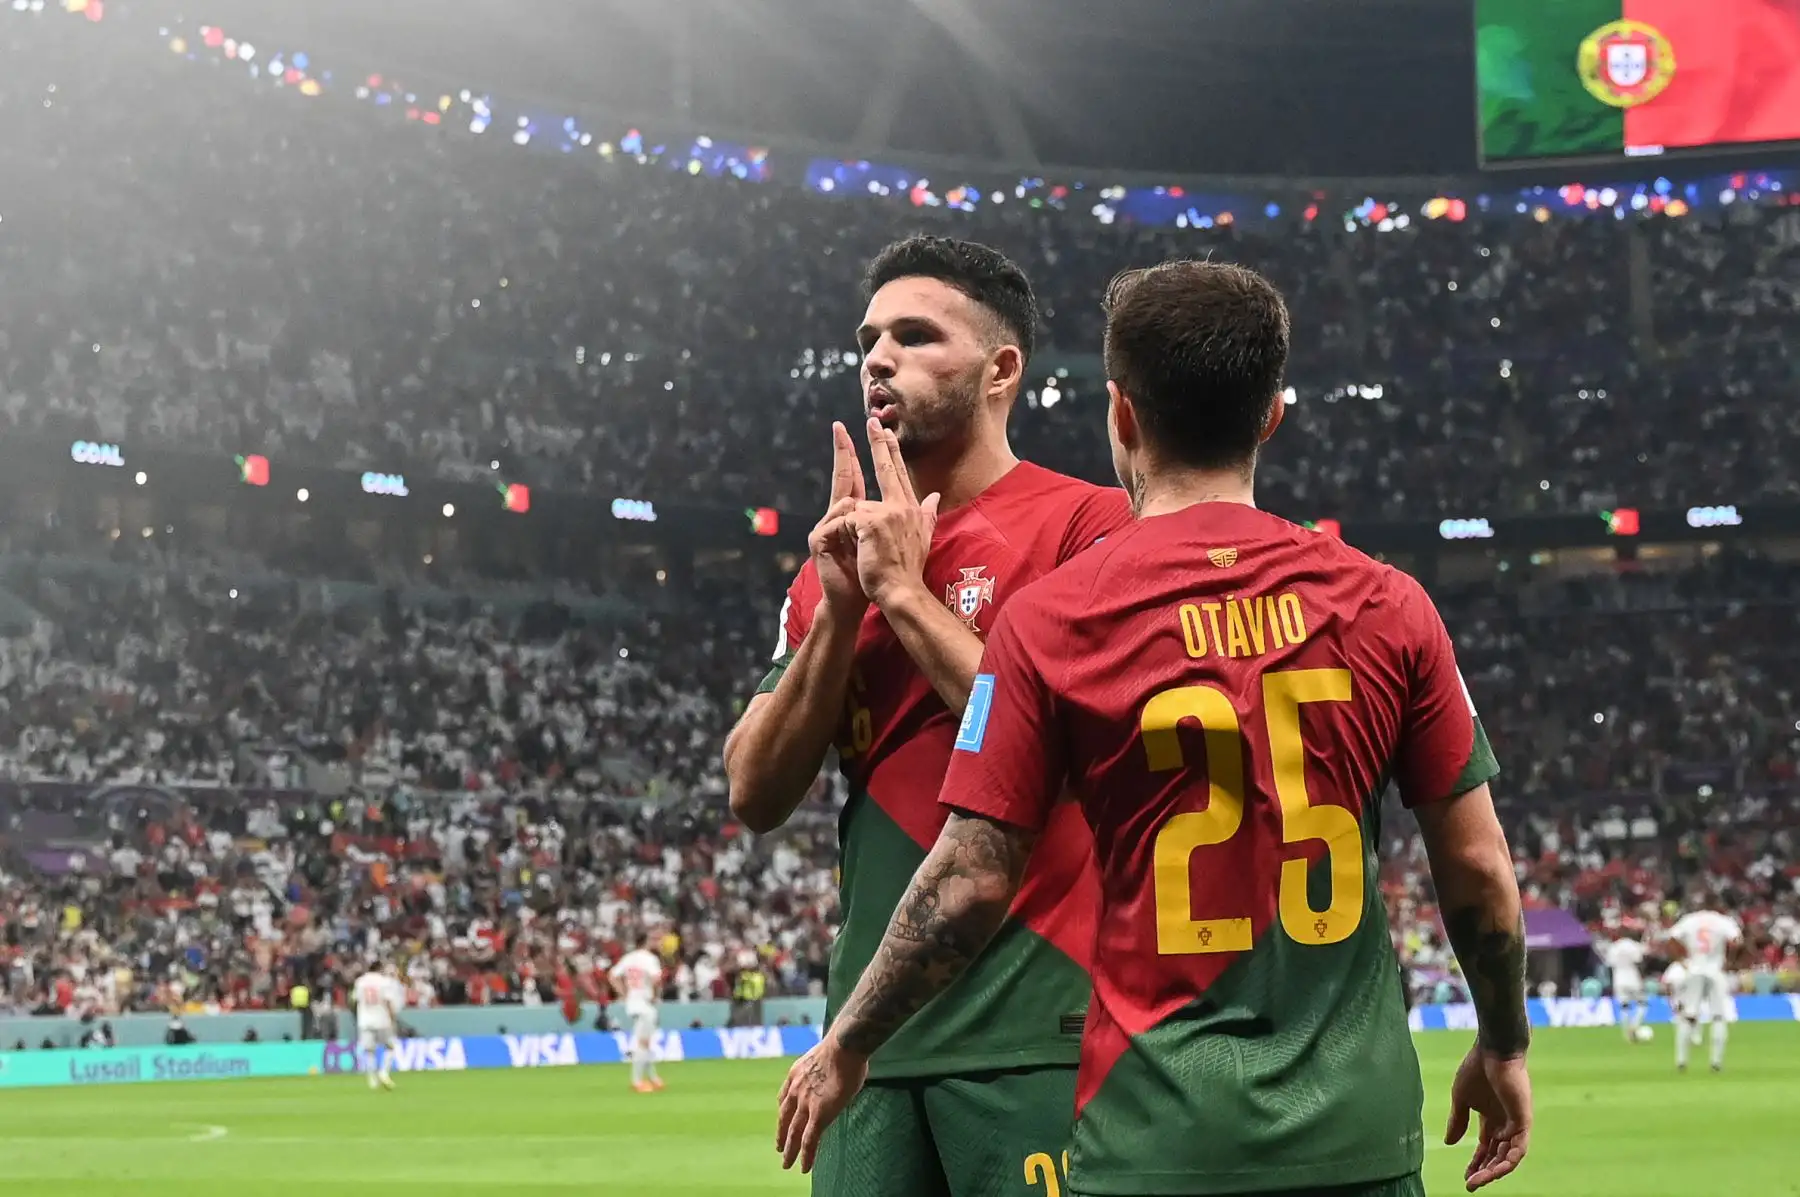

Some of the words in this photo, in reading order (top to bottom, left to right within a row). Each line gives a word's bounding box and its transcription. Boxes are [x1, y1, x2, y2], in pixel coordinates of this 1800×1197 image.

[1179, 594, 1307, 659] OTÁVIO
[1141, 668, 1364, 955] 25
[391, 1036, 467, 1072] VISA
[502, 1032, 579, 1068] VISA
[715, 1025, 784, 1060] VISA
[69, 1055, 140, 1082] Lusail
[153, 1052, 250, 1079] Stadium
[1024, 1152, 1068, 1197] 2
